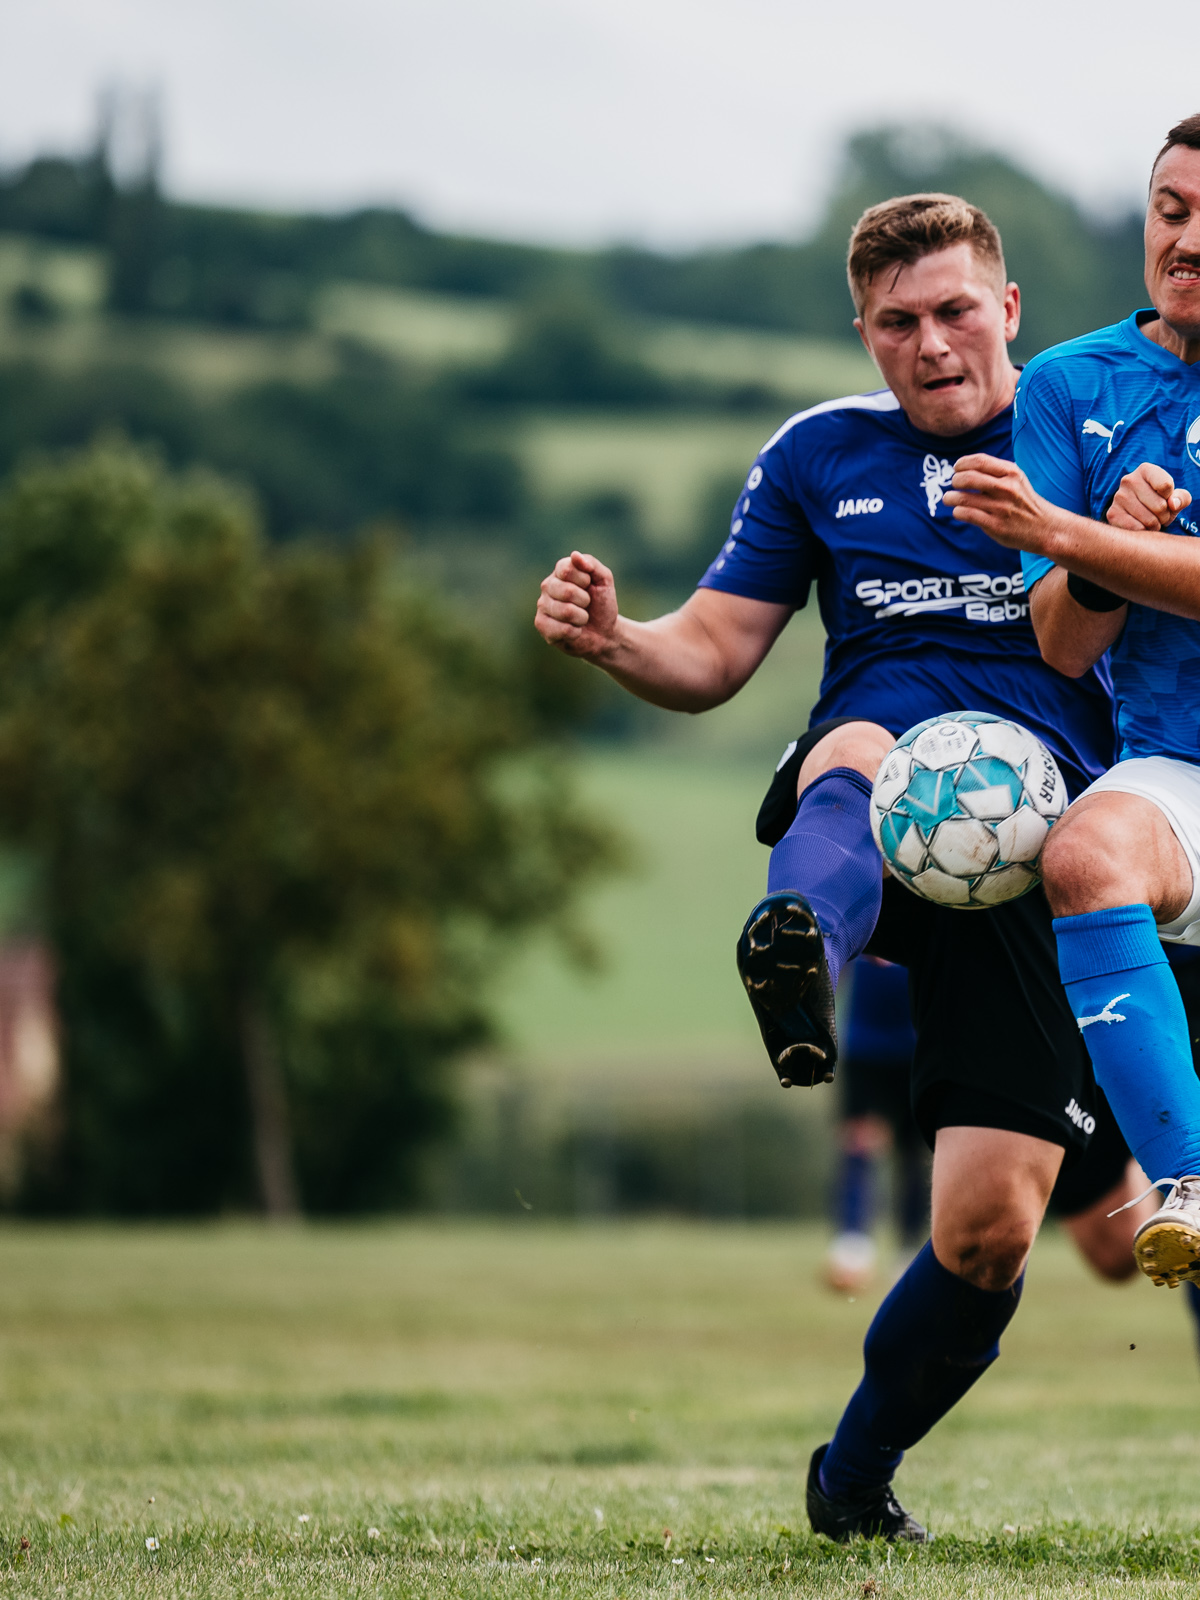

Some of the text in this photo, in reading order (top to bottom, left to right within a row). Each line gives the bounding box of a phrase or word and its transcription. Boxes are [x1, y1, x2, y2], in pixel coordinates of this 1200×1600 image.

[835, 498, 884, 519] JAKO
[958, 571, 1026, 598] ROS
[965, 600, 1031, 623] Bebr
[1064, 1097, 1096, 1135] JAKO
